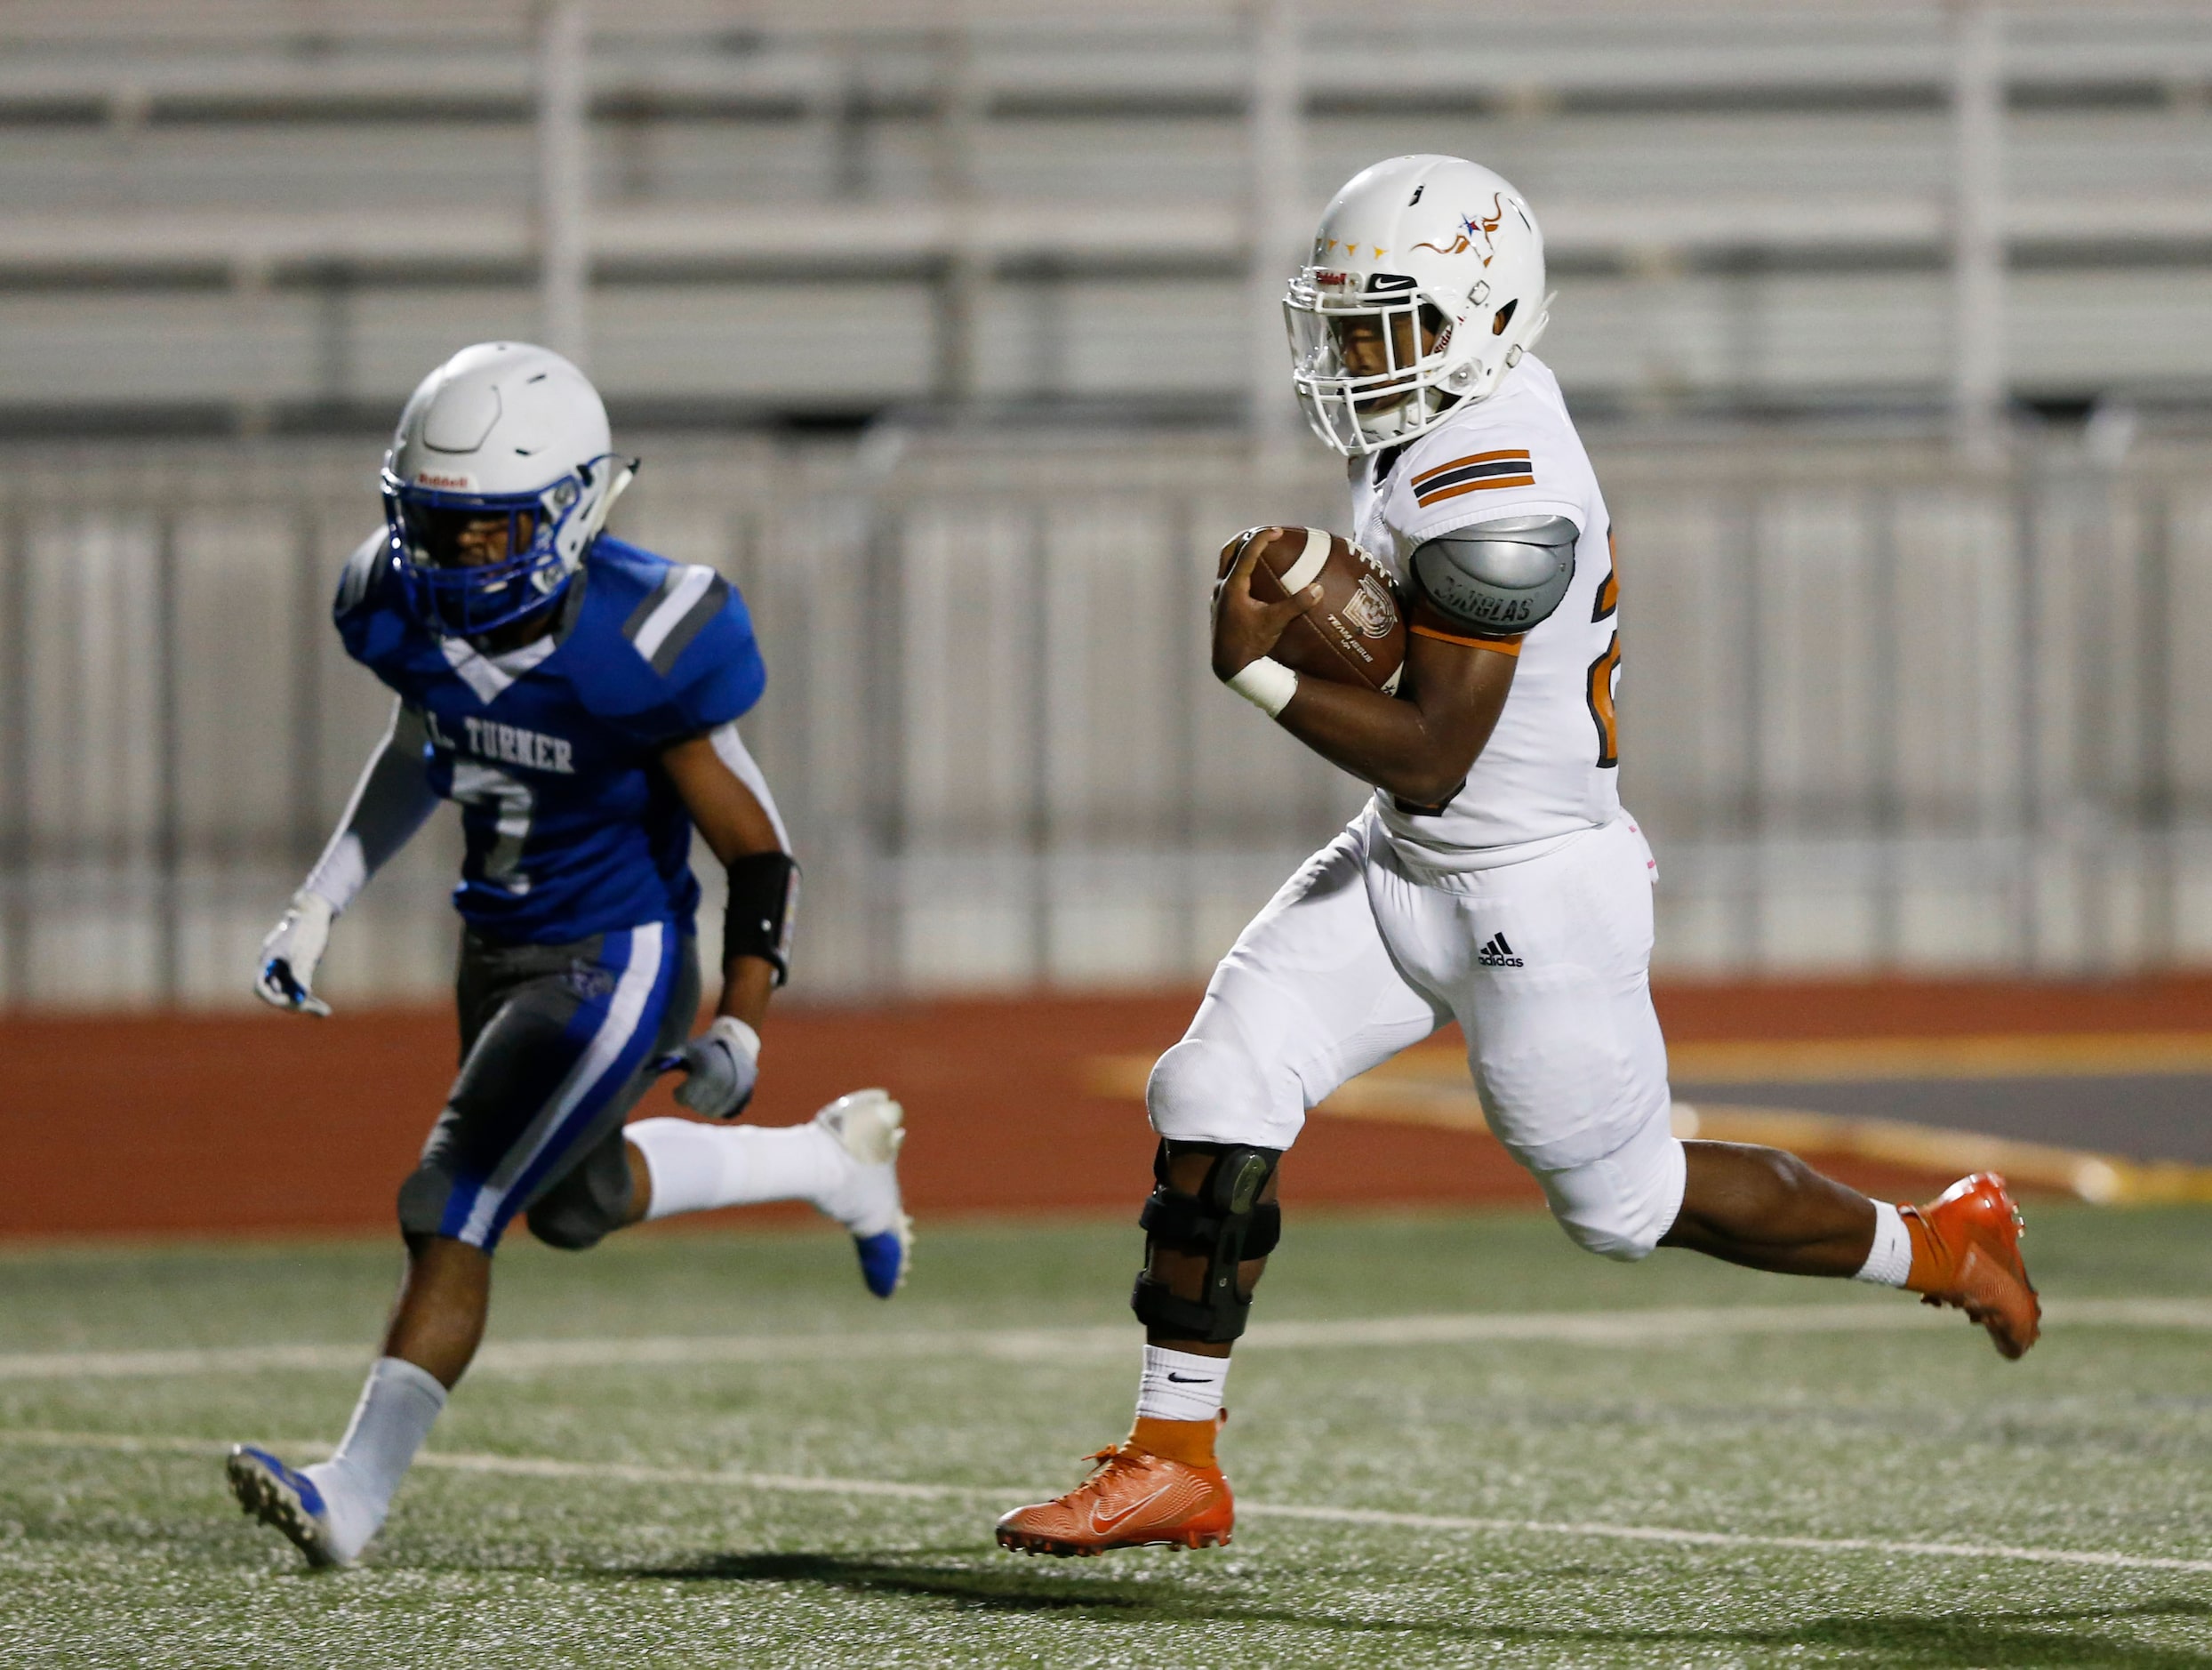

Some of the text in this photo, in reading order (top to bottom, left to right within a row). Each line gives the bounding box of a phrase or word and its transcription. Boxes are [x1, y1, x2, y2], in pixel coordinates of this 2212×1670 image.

[463, 716, 575, 774] TURNER
[451, 761, 533, 895] 7
[1478, 954, 1524, 967] adidas
